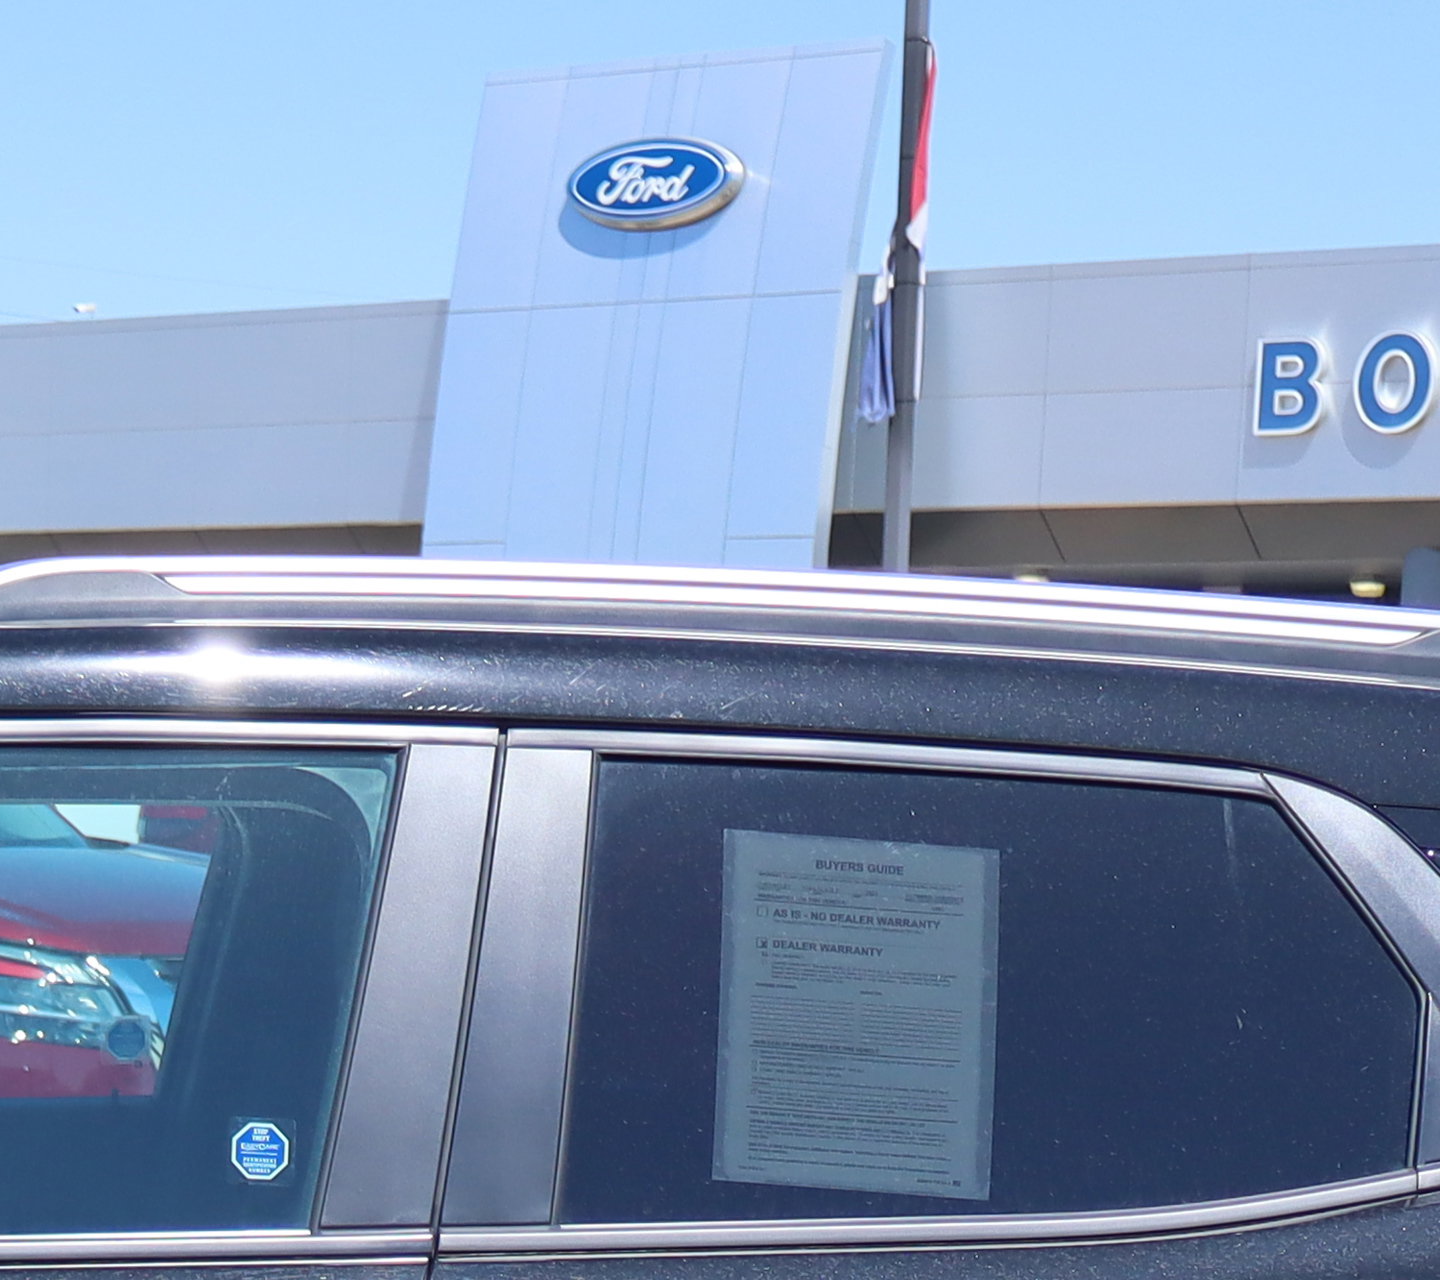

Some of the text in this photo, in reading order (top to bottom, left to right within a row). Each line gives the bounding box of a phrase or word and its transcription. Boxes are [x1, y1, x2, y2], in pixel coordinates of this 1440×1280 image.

[595, 155, 695, 206] Ford
[815, 859, 905, 876] BUYERS GUIDE
[773, 908, 789, 919] AS
[790, 910, 803, 920] IS
[810, 911, 827, 922] NO
[829, 914, 874, 926] DEALER
[876, 916, 941, 931] WARRANTY
[772, 939, 818, 952] DEALER
[820, 942, 884, 957] WARRANTY
